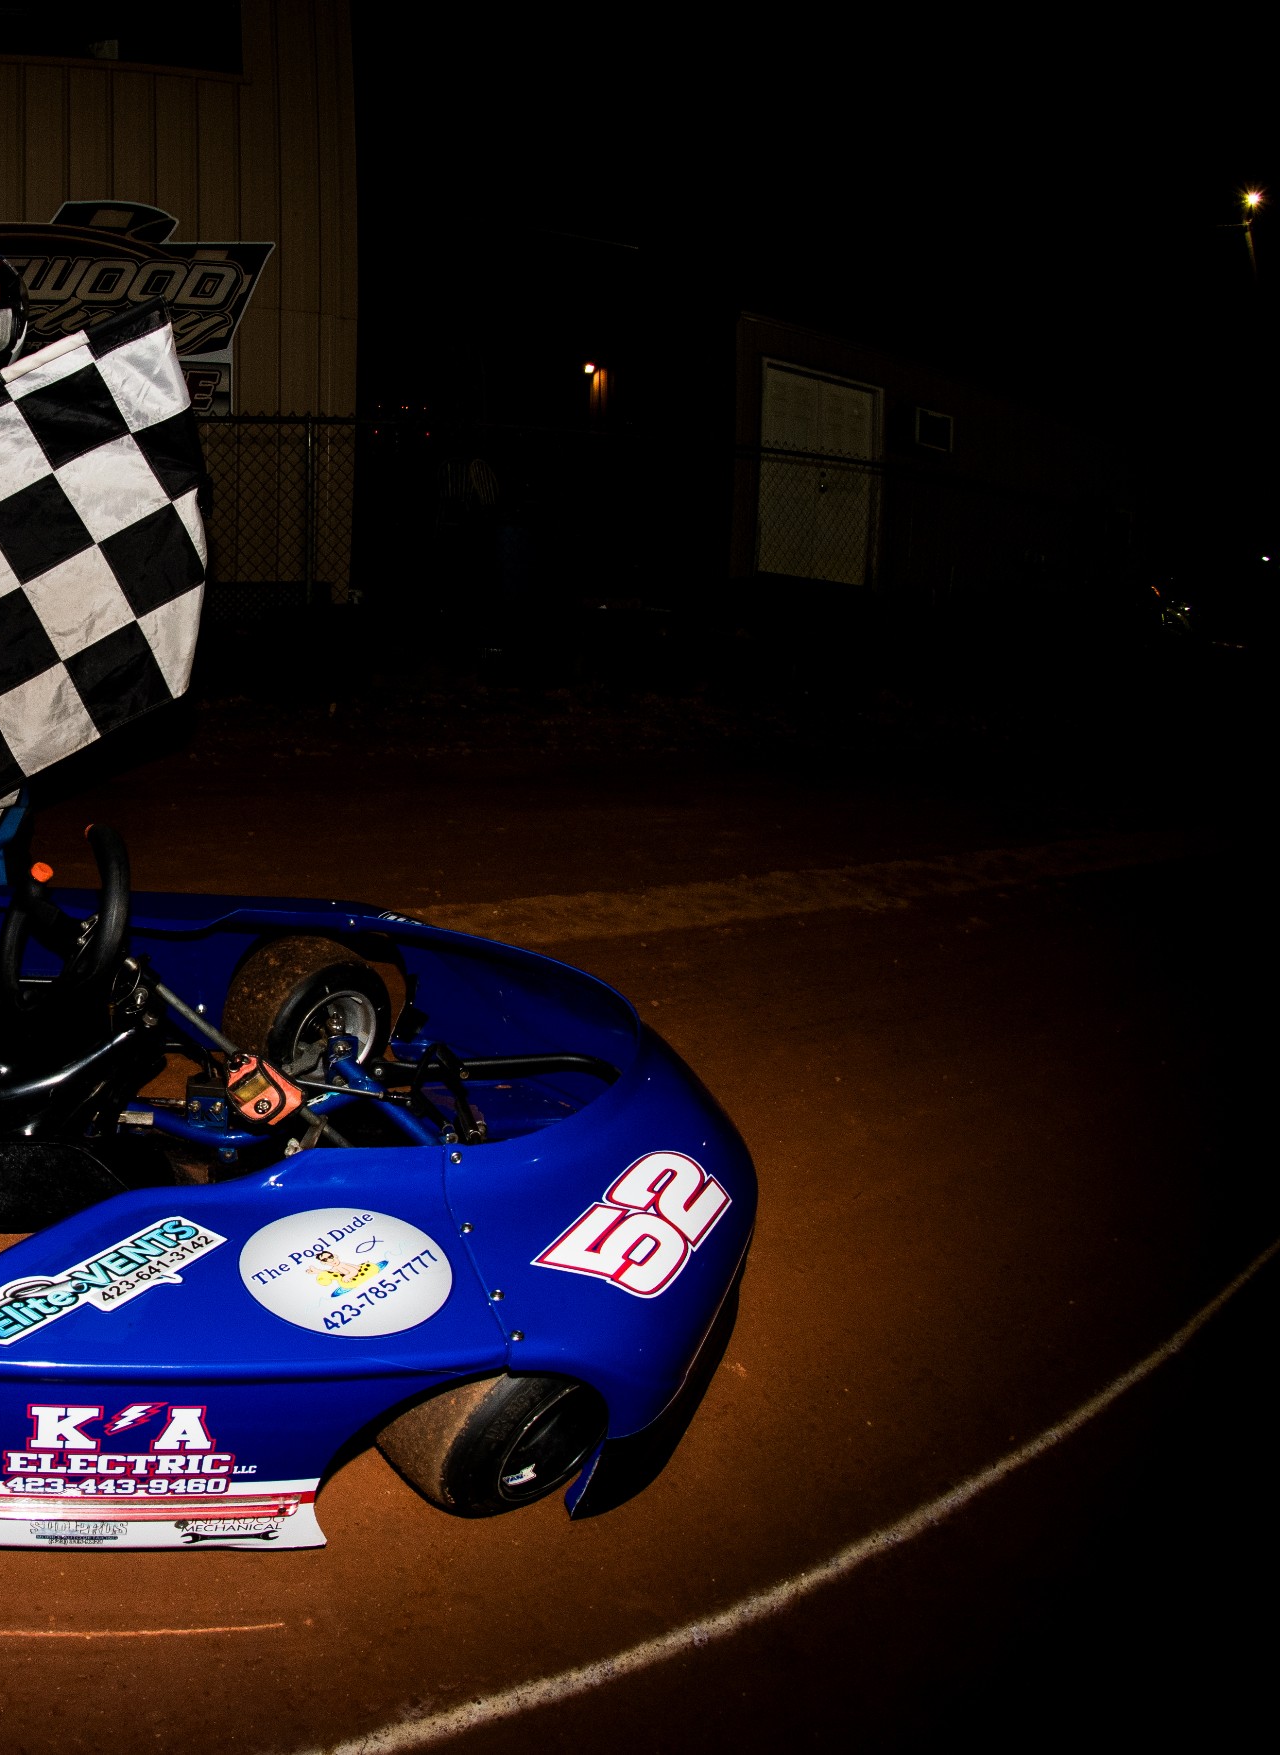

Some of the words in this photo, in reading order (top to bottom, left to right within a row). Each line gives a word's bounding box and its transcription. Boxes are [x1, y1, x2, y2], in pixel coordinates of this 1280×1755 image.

[70, 1219, 199, 1288] VENTS
[251, 1262, 290, 1286] The
[288, 1238, 330, 1266] Pool
[327, 1213, 374, 1242] Dude
[531, 1151, 732, 1298] 52
[101, 1235, 213, 1302] 423-641-3142
[322, 1249, 438, 1331] 423-785-7777
[3, 1450, 235, 1475] ELECTRIC
[233, 1464, 258, 1475] LLC
[4, 1476, 231, 1496] 423-443-9460
[181, 1523, 282, 1532] MECHANICAL
